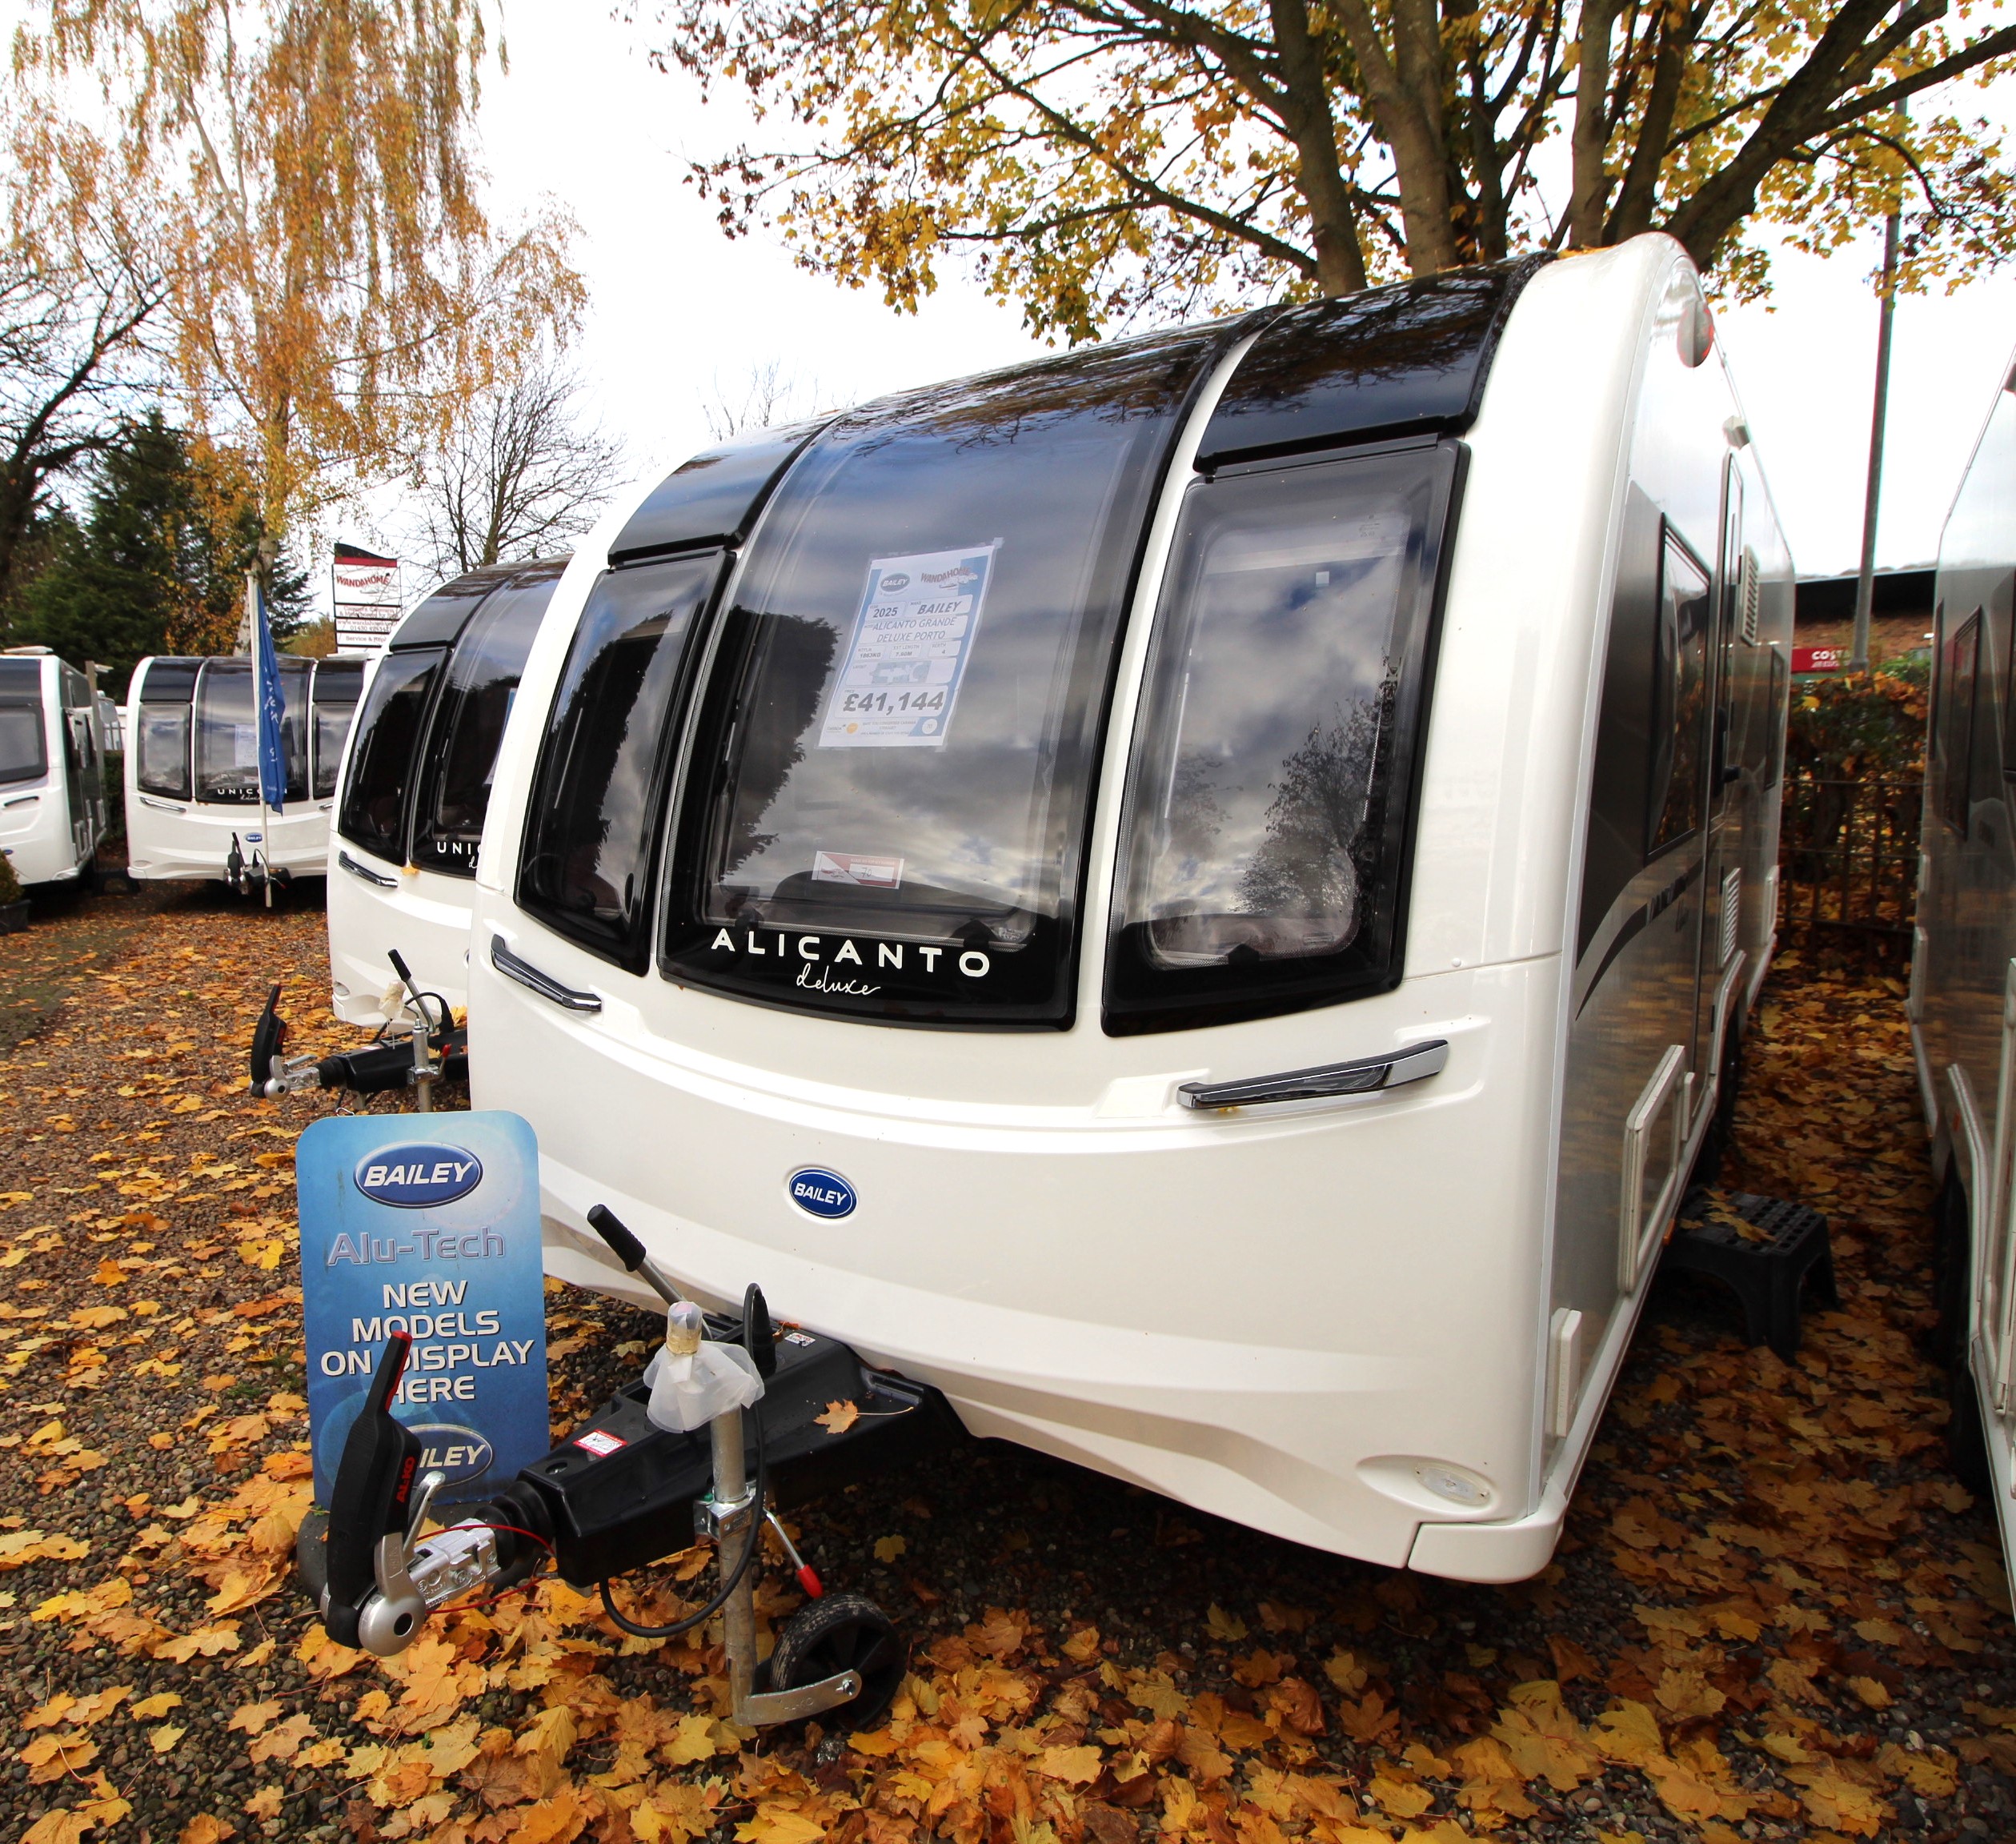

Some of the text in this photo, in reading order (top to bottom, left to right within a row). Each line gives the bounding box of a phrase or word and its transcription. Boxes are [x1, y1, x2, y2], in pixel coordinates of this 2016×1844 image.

[336, 575, 391, 588] WANDAHOME
[882, 579, 908, 587] BAILEY
[920, 567, 971, 583] WANDAHOME
[873, 607, 898, 618] 2025
[917, 601, 962, 615] BAILEY
[872, 616, 957, 631] ALICANTO GRANDE
[876, 631, 946, 643] DELUXE PORTO
[843, 691, 944, 716] £41,144
[711, 928, 990, 977] ALICANTO
[796, 963, 880, 996] deluxe
[363, 1161, 474, 1187] BAILEY
[794, 1183, 848, 1206] BAILEY
[327, 1227, 505, 1266] Alu-Tech
[383, 1281, 467, 1309] NEW
[352, 1310, 500, 1343] MODELS
[320, 1350, 371, 1376] ON
[419, 1444, 486, 1468] ILEY
[396, 1457, 415, 1503] AL-KO
